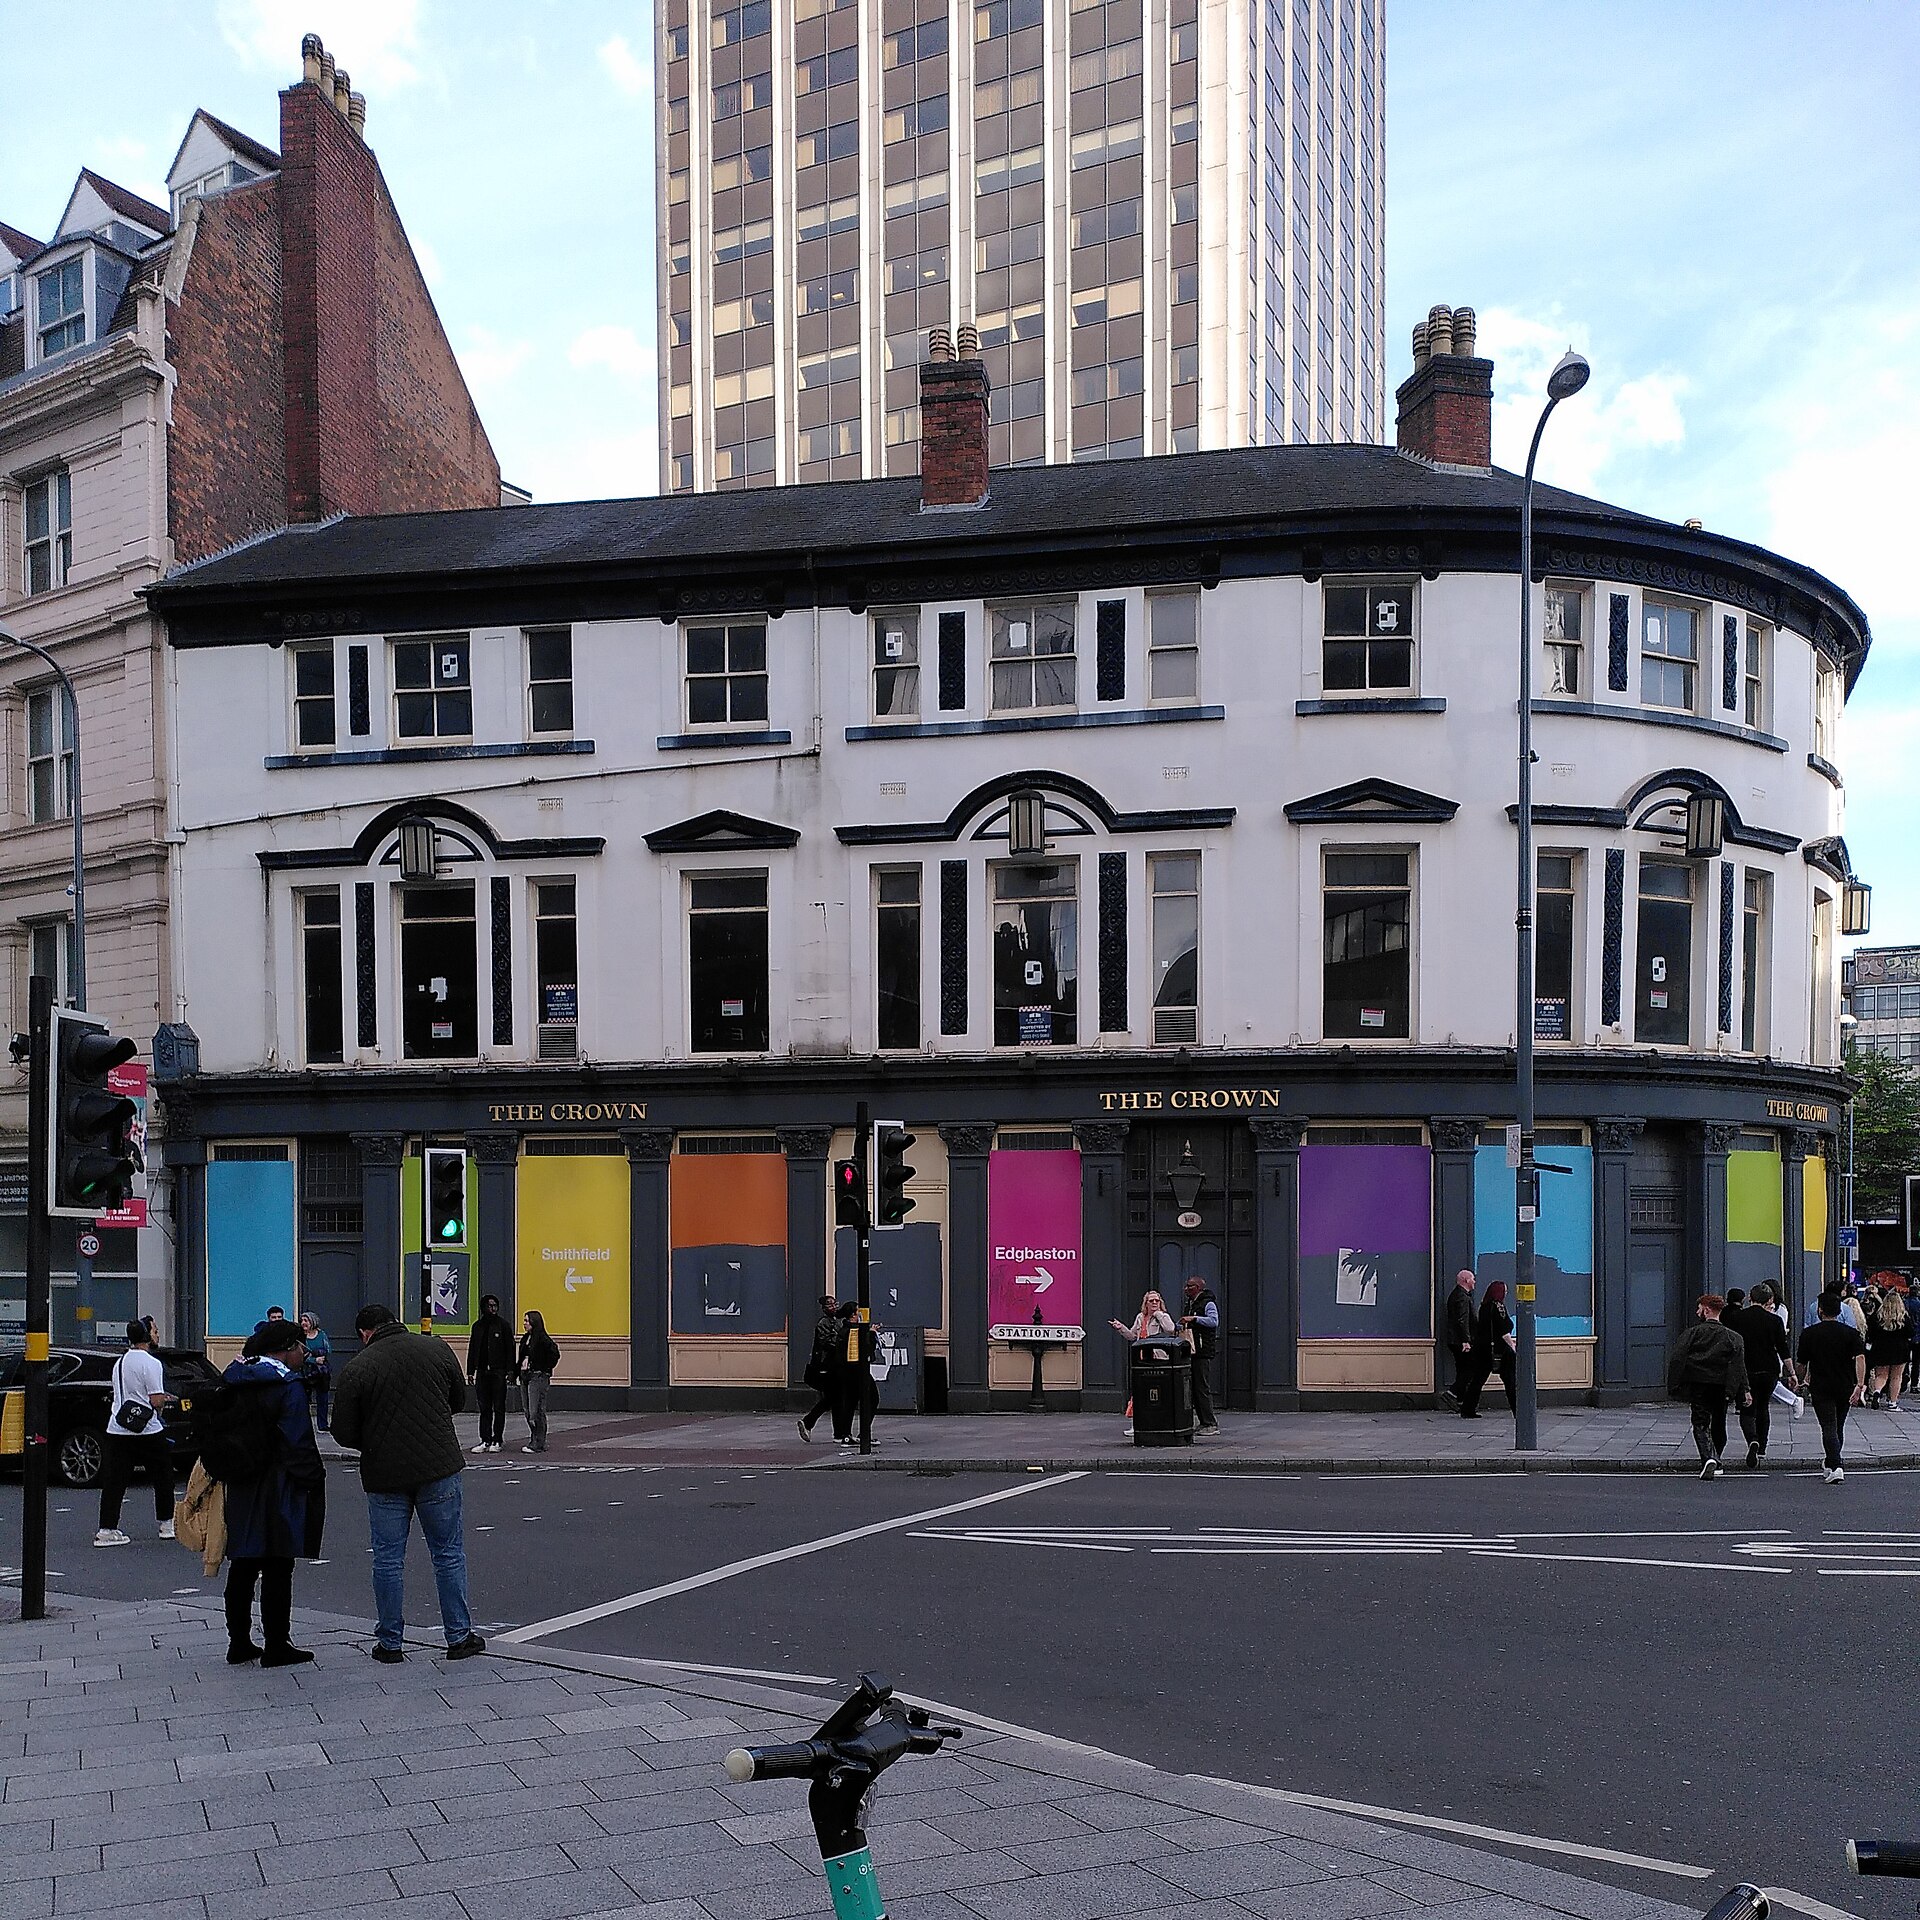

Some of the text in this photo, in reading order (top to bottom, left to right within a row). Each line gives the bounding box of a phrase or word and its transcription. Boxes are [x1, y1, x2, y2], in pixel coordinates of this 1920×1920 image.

[1100, 1089, 1281, 1110] THE CROWN
[488, 1102, 648, 1121] THE CROWN
[1766, 1099, 1828, 1123] THE CROWN
[82, 1240, 98, 1251] 20
[541, 1247, 610, 1261] Smithfield
[995, 1246, 1076, 1263] Edgbaston
[999, 1328, 1050, 1338] STATION
[1056, 1329, 1070, 1339] ST
